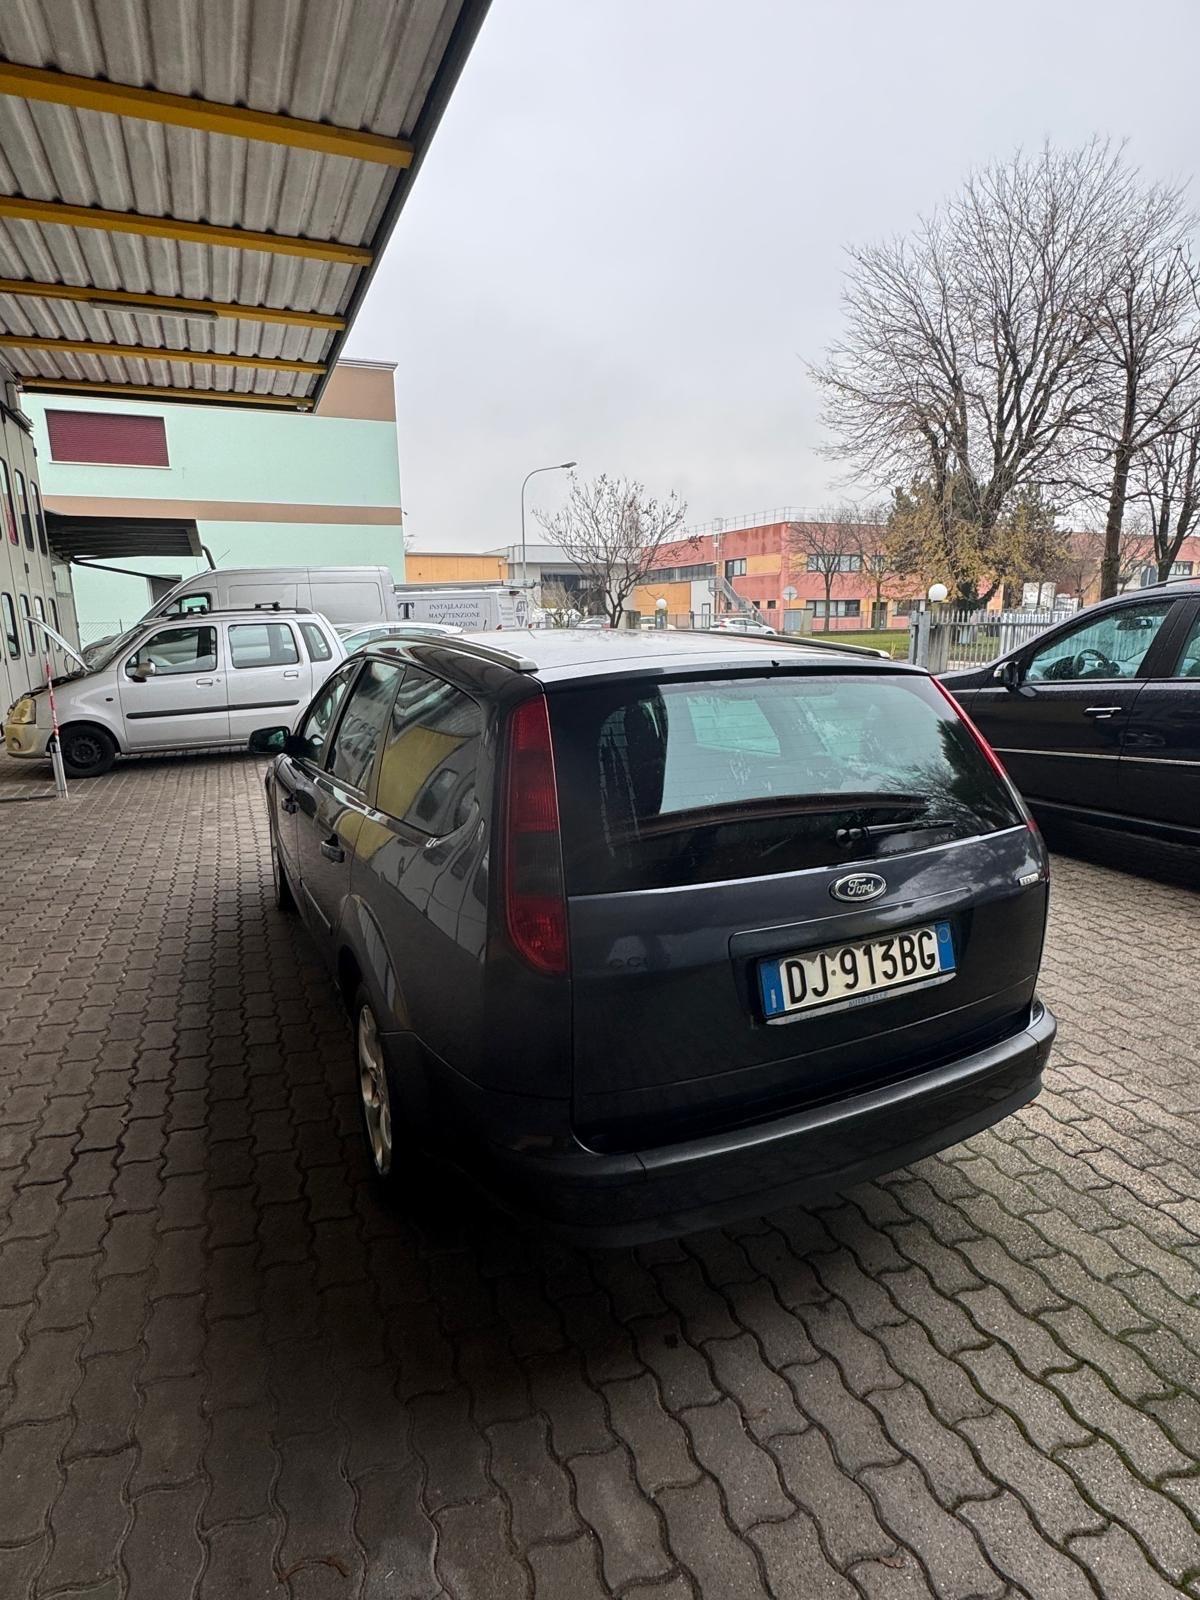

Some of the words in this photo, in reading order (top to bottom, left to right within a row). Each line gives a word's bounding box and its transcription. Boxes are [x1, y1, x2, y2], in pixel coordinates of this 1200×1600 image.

[429, 602, 479, 610] INSTALLAZIONE
[428, 611, 481, 619] MANUTENZIONE
[433, 620, 478, 628] OMAZIONI
